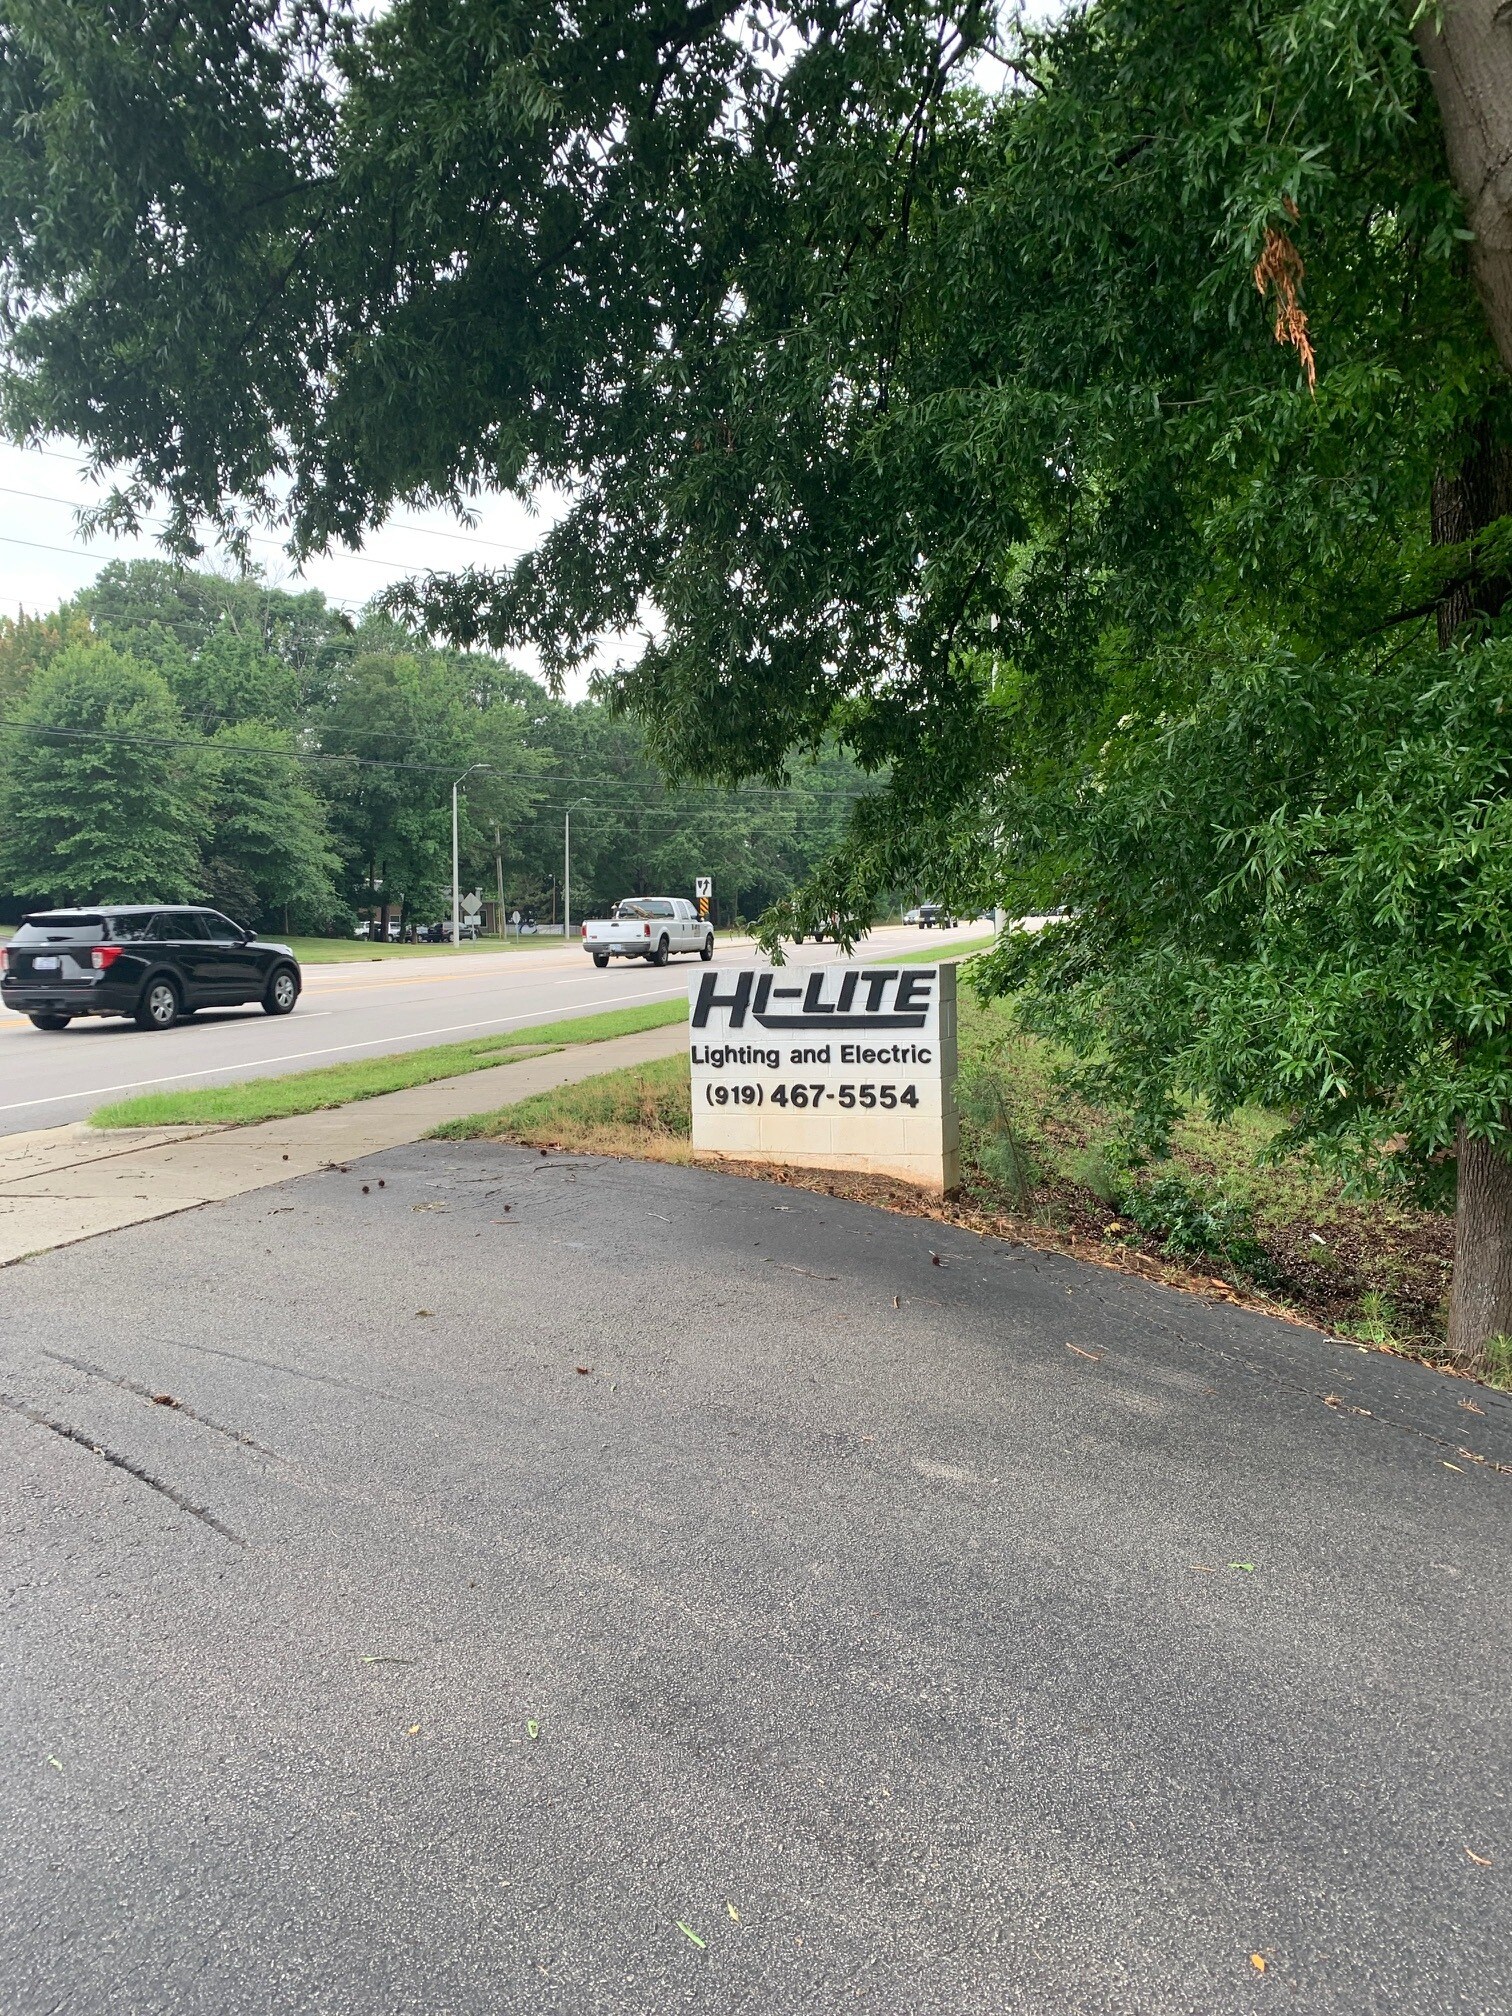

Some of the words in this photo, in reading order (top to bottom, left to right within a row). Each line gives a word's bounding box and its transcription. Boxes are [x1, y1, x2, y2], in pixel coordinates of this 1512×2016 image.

[692, 970, 937, 1028] HI-LITE
[691, 1045, 780, 1068] Lighting
[790, 1045, 831, 1064] and
[840, 1044, 932, 1064] Electric
[706, 1083, 764, 1106] (919)
[770, 1084, 919, 1109] 467-5554
